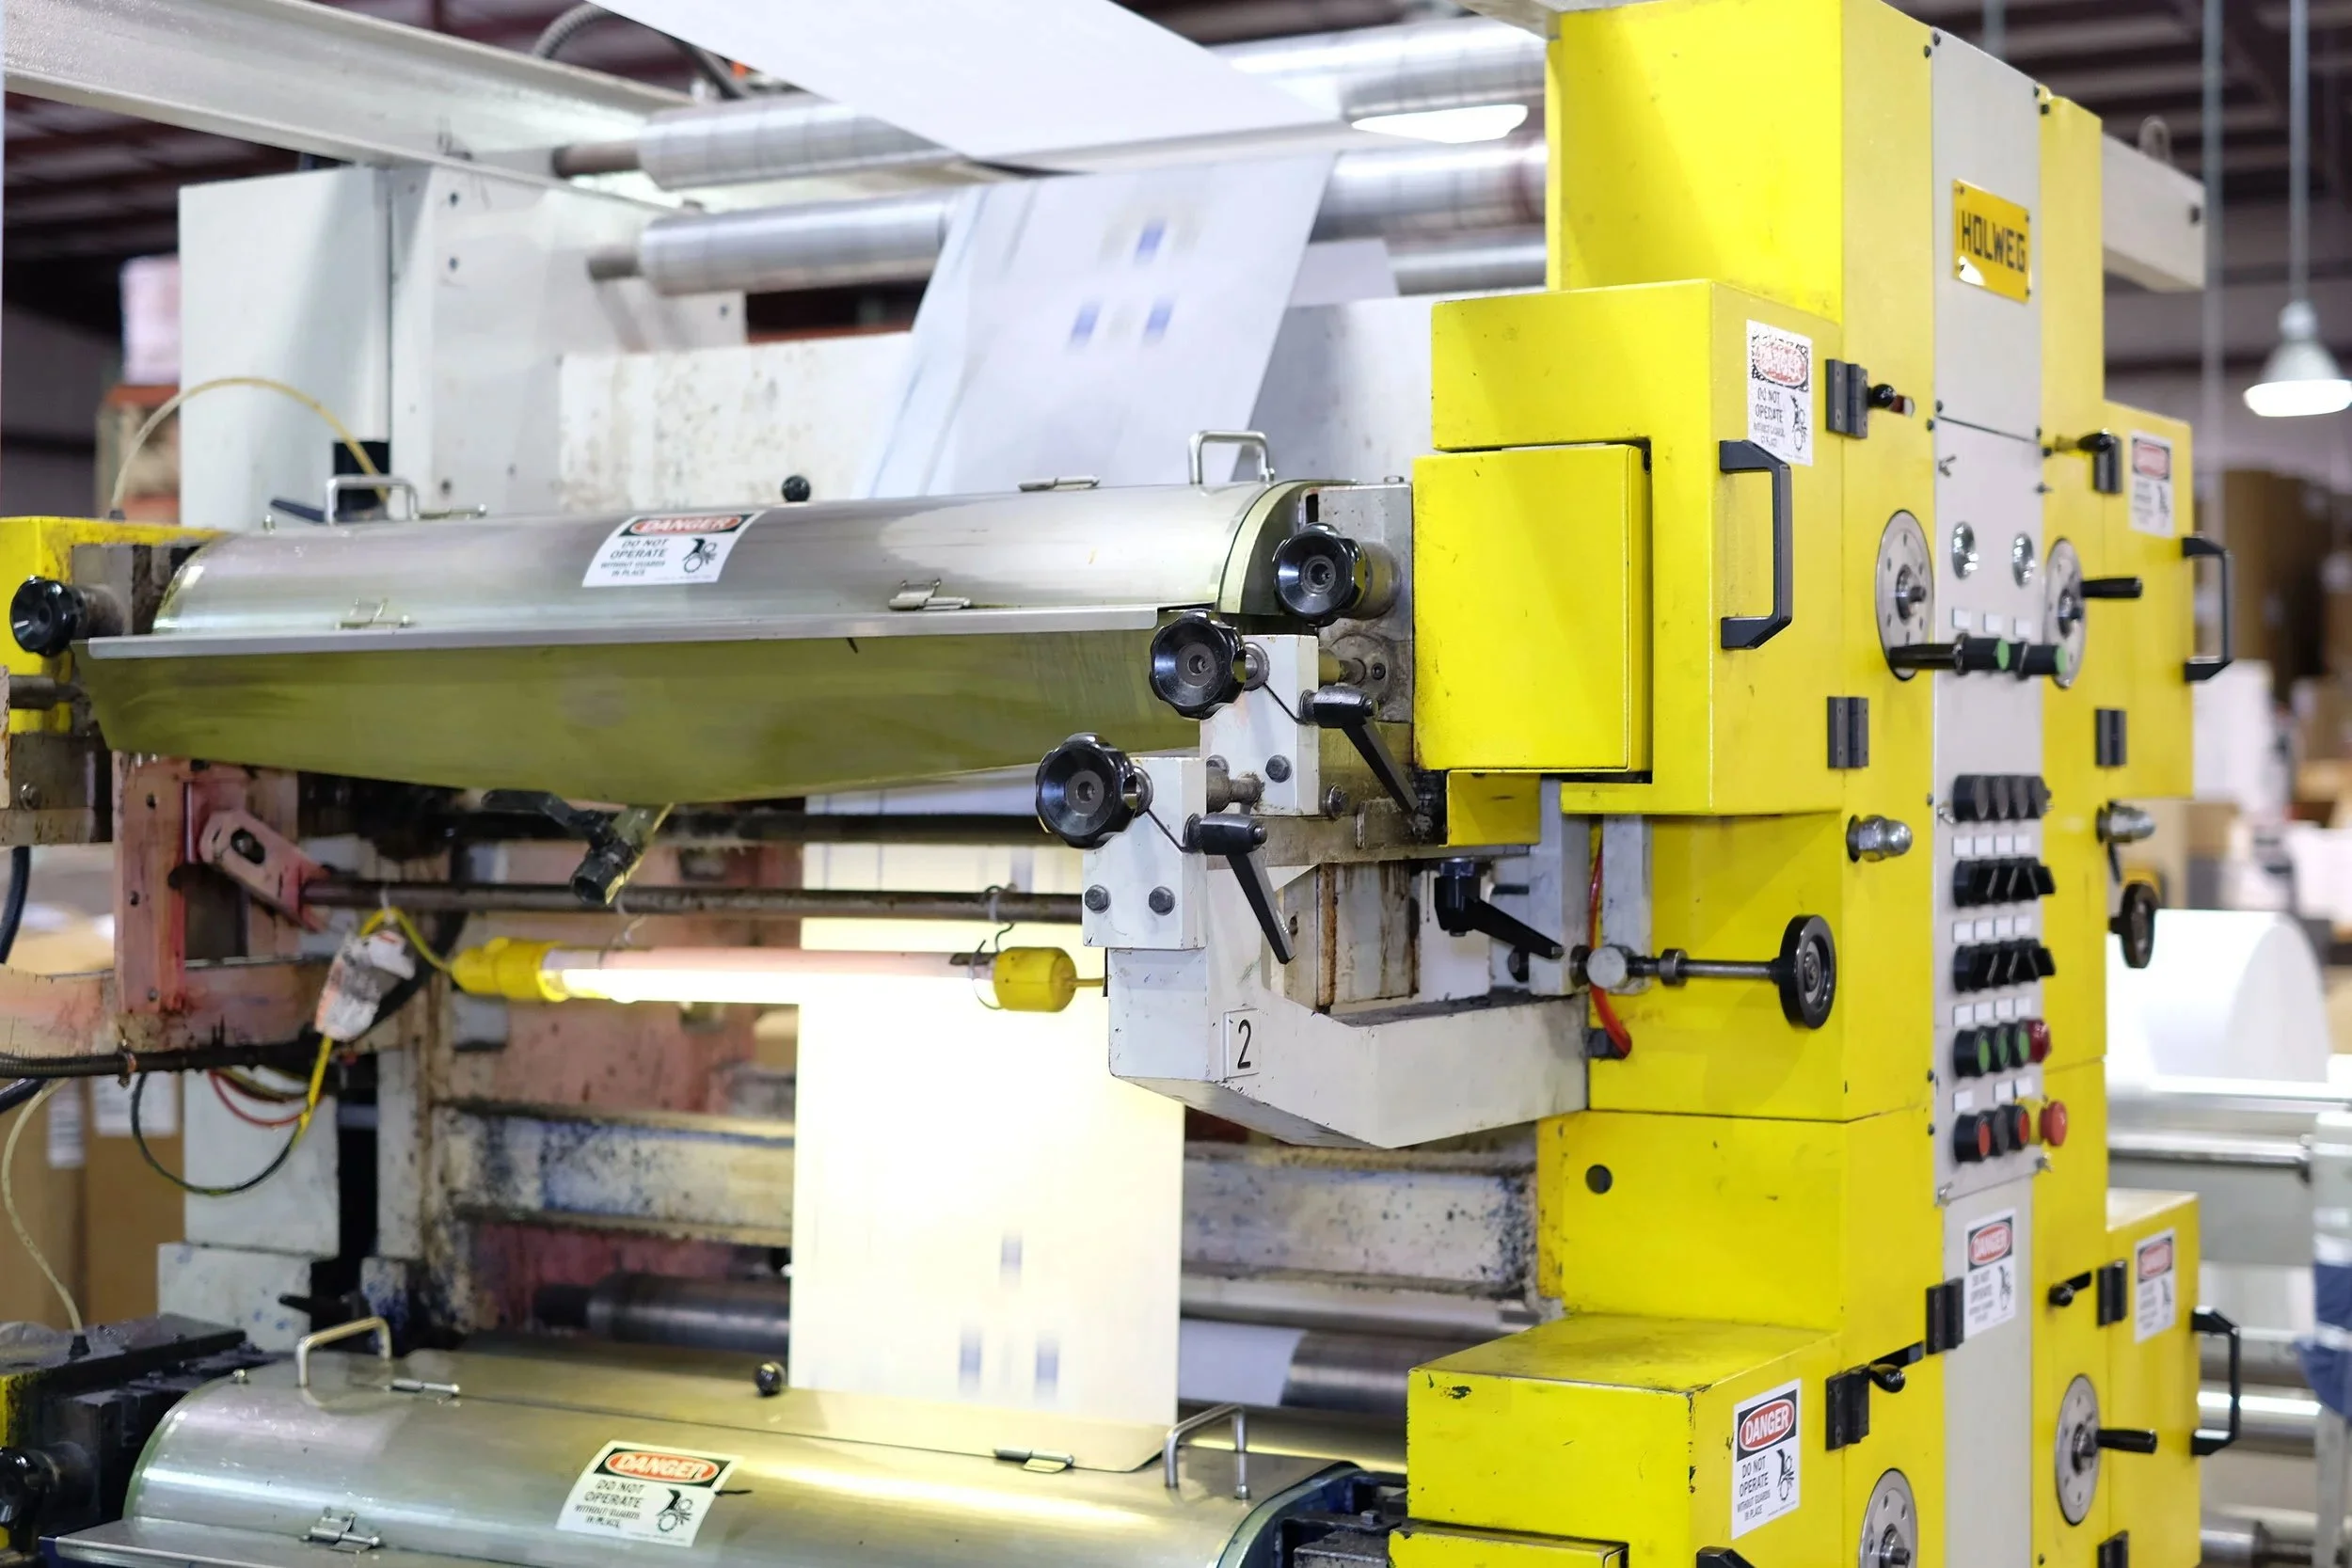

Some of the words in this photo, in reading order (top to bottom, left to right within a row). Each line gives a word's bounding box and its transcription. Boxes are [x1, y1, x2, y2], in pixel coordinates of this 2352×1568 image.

[1962, 210, 2026, 273] HOLWEG
[1769, 389, 1780, 405] NOT
[643, 516, 730, 532] DANGER
[622, 539, 641, 548] DO
[644, 538, 669, 547] NOT
[610, 548, 668, 560] OPERATE
[1237, 1019, 1251, 1069] 2
[1745, 1404, 1789, 1445] DANGER
[615, 1454, 707, 1480] DANGER
[1741, 1461, 1752, 1478] DO
[1753, 1455, 1767, 1474] NOT
[595, 1479, 616, 1491] DO
[619, 1481, 645, 1495] NOT
[1740, 1472, 1769, 1497] OPERATE
[584, 1491, 644, 1509] OPERATE
